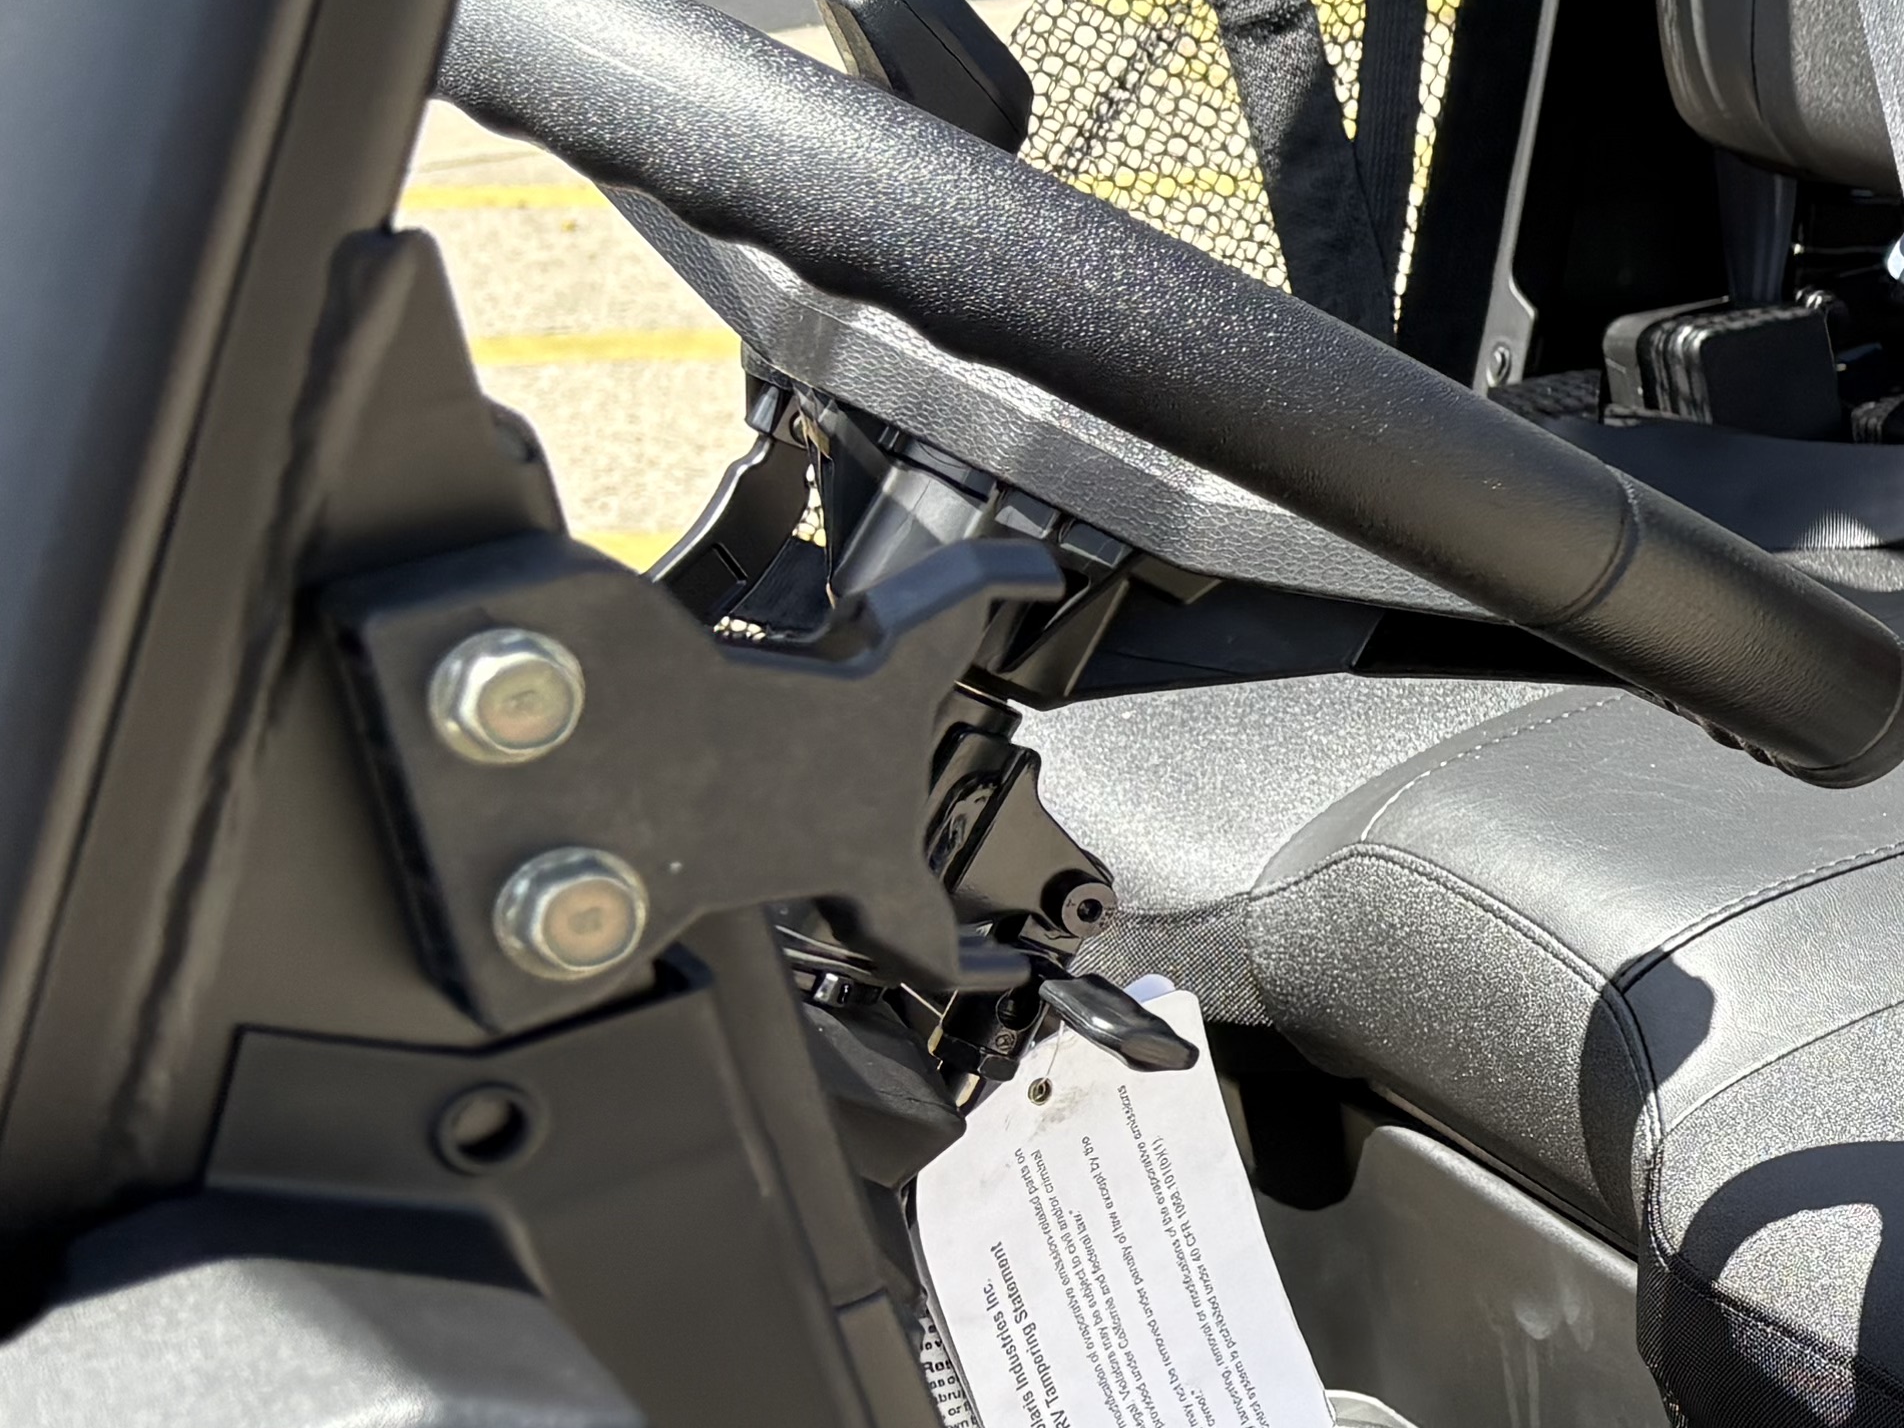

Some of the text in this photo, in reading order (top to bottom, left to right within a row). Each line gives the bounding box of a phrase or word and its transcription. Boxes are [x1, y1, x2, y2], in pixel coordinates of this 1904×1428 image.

[990, 1241, 1028, 1324] Statement
[1079, 1234, 1102, 1274] federal
[983, 1279, 999, 1312] Inc.
[993, 1310, 1029, 1391] Industries
[1022, 1322, 1059, 1409] Tampering
